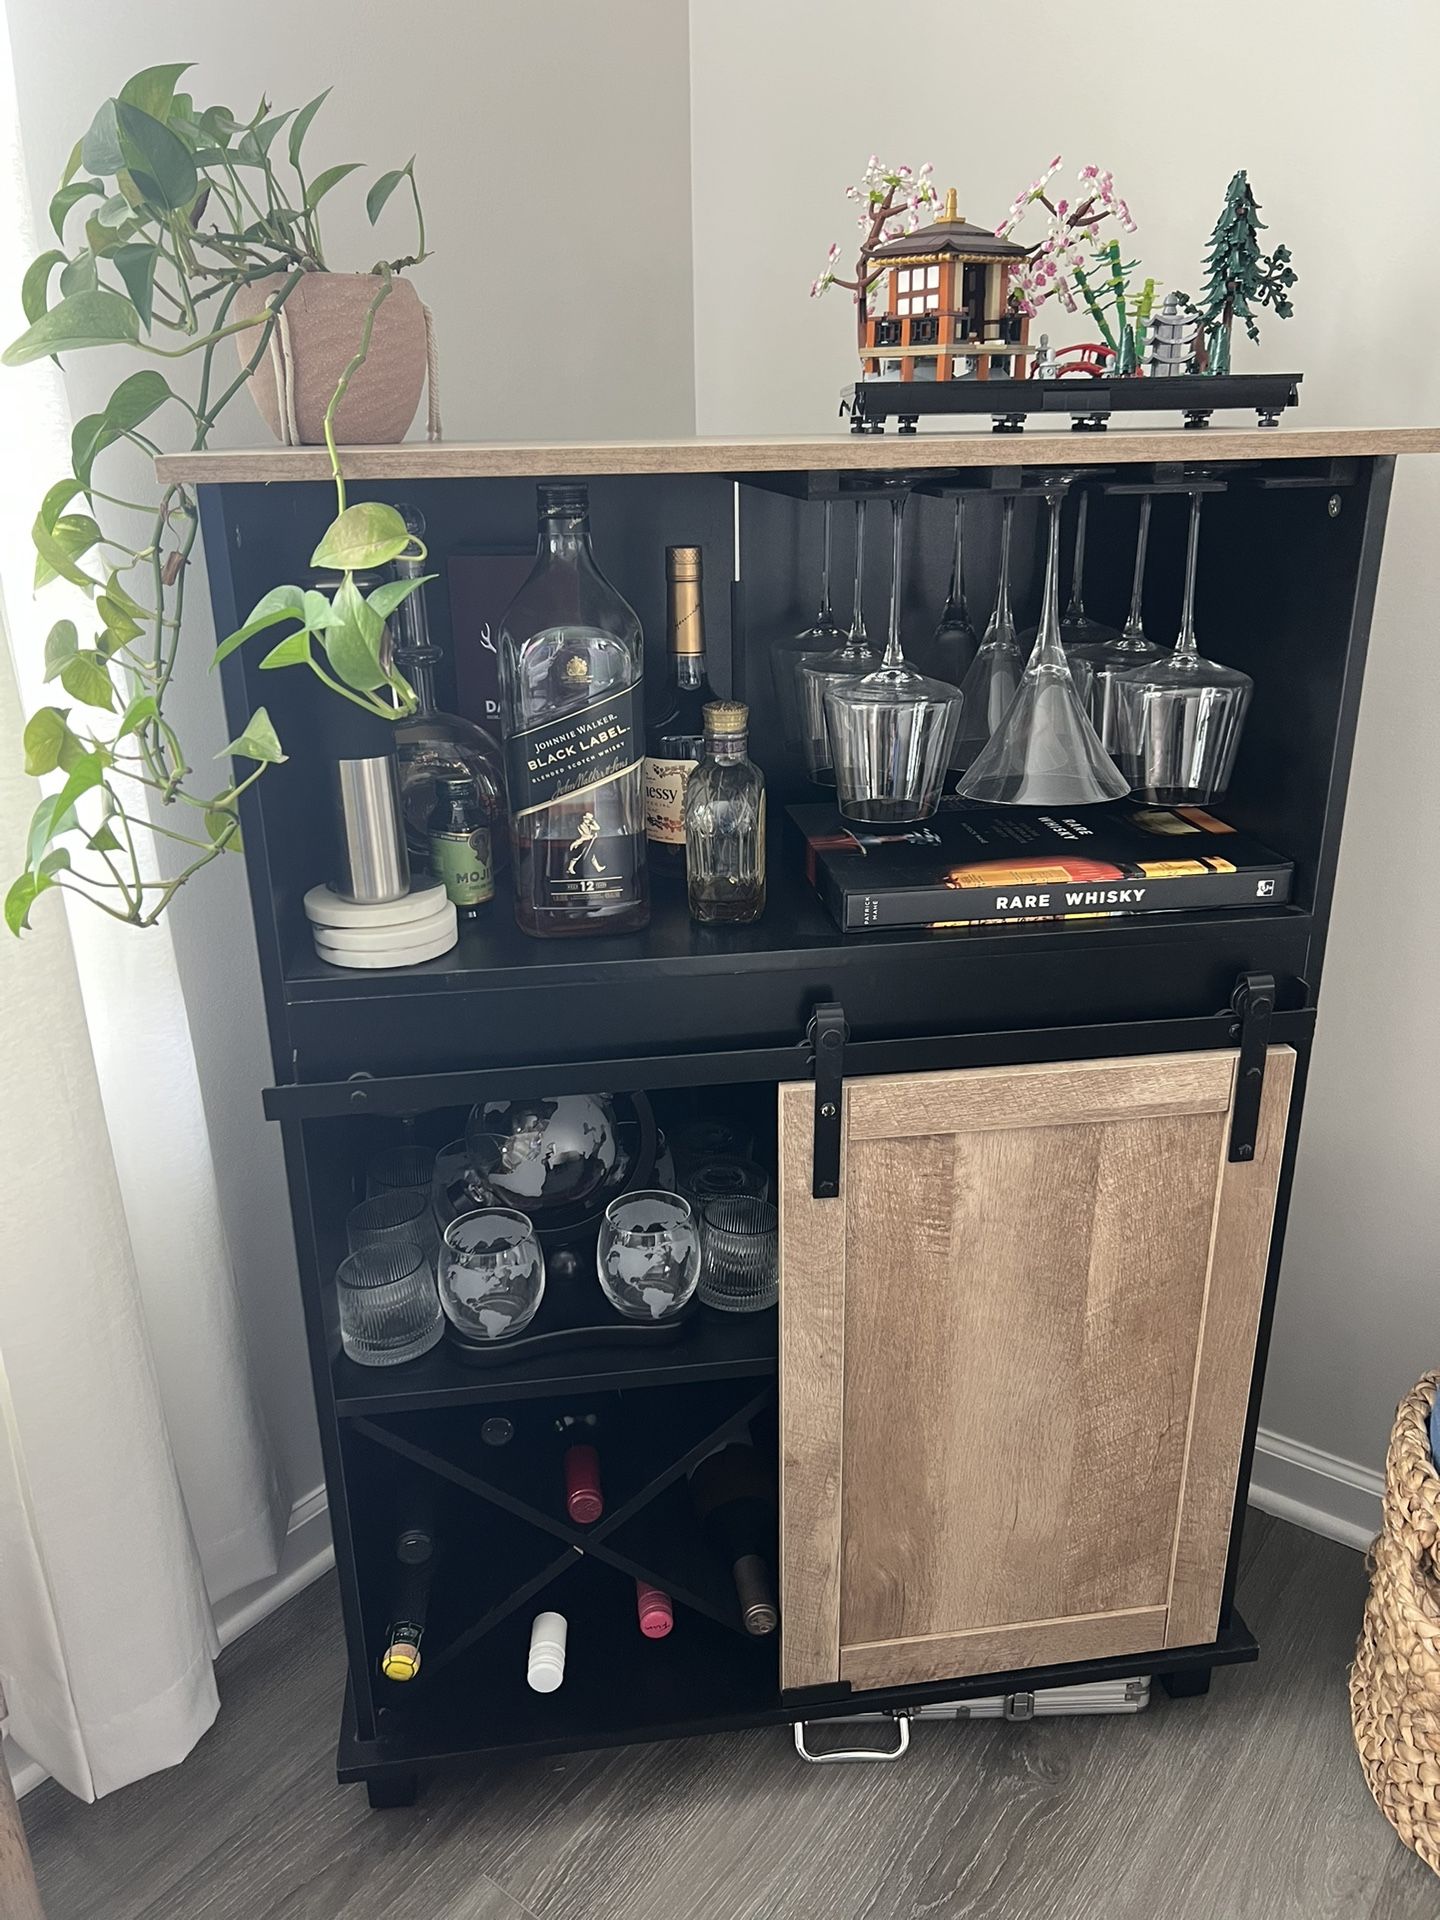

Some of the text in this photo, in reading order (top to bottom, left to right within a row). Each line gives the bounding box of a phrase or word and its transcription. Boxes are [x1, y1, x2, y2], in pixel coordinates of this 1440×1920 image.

[534, 713, 616, 754] JOHNNIE WALKER
[527, 724, 628, 771] BLACK LABEL
[531, 742, 625, 783] BLENDED SCOTCH WHISKY
[1037, 816, 1080, 841] WHISKY
[1062, 818, 1094, 836] RARE
[580, 881, 595, 892] 12
[996, 888, 1146, 910] RARE WHISKY
